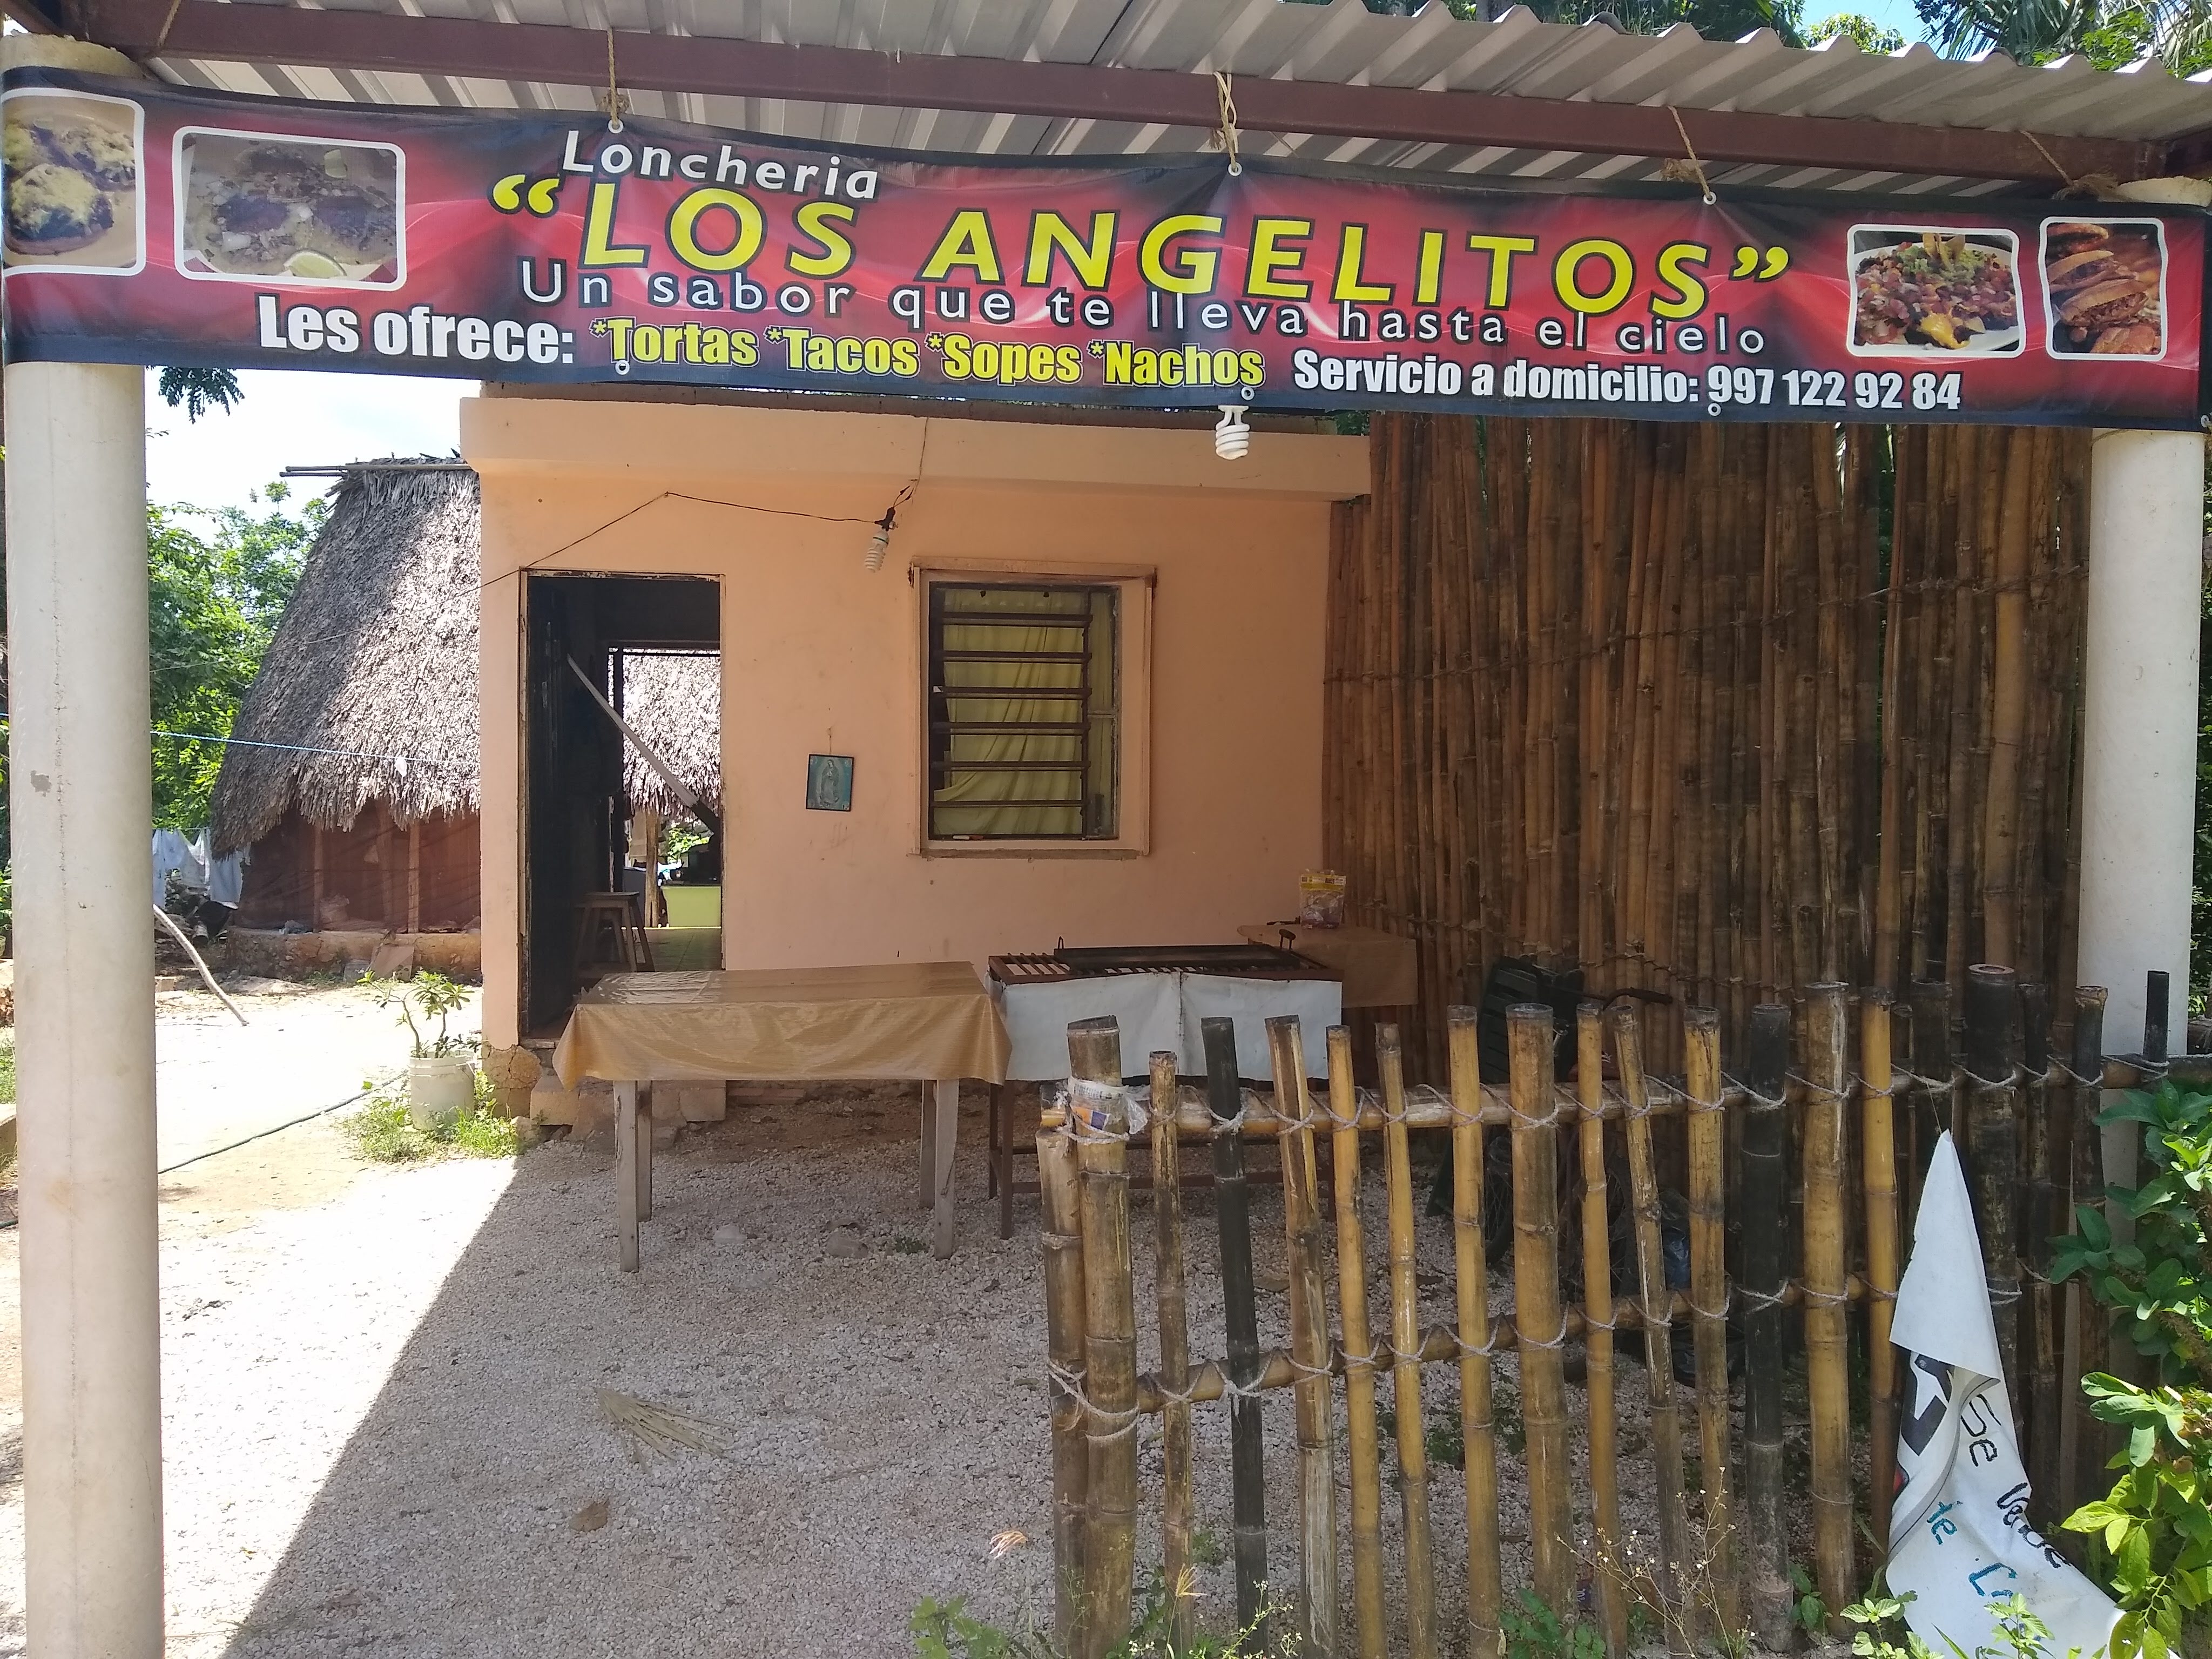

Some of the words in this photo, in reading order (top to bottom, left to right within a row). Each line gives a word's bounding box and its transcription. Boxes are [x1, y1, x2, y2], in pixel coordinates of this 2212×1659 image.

[562, 130, 878, 200] Loncheria
[258, 296, 359, 352] Les
[374, 306, 575, 364] ofrece:
[522, 260, 608, 304] Un
[653, 272, 850, 314] sabor
[892, 288, 1011, 328] que
[1050, 292, 1110, 325] te
[1151, 291, 1304, 334] lleva
[1343, 301, 1505, 343] hasta
[1539, 312, 1585, 349] el
[1616, 316, 1764, 354] cielo
[1294, 350, 1462, 395] Servicio
[1471, 368, 1495, 396] a
[1504, 359, 1700, 402] domicilio:
[1708, 366, 1774, 405] 997
[1783, 370, 1846, 407] 122
[1856, 372, 1903, 409] 92
[1913, 373, 1961, 411] 84
[1961, 1393, 2001, 1467] Se
